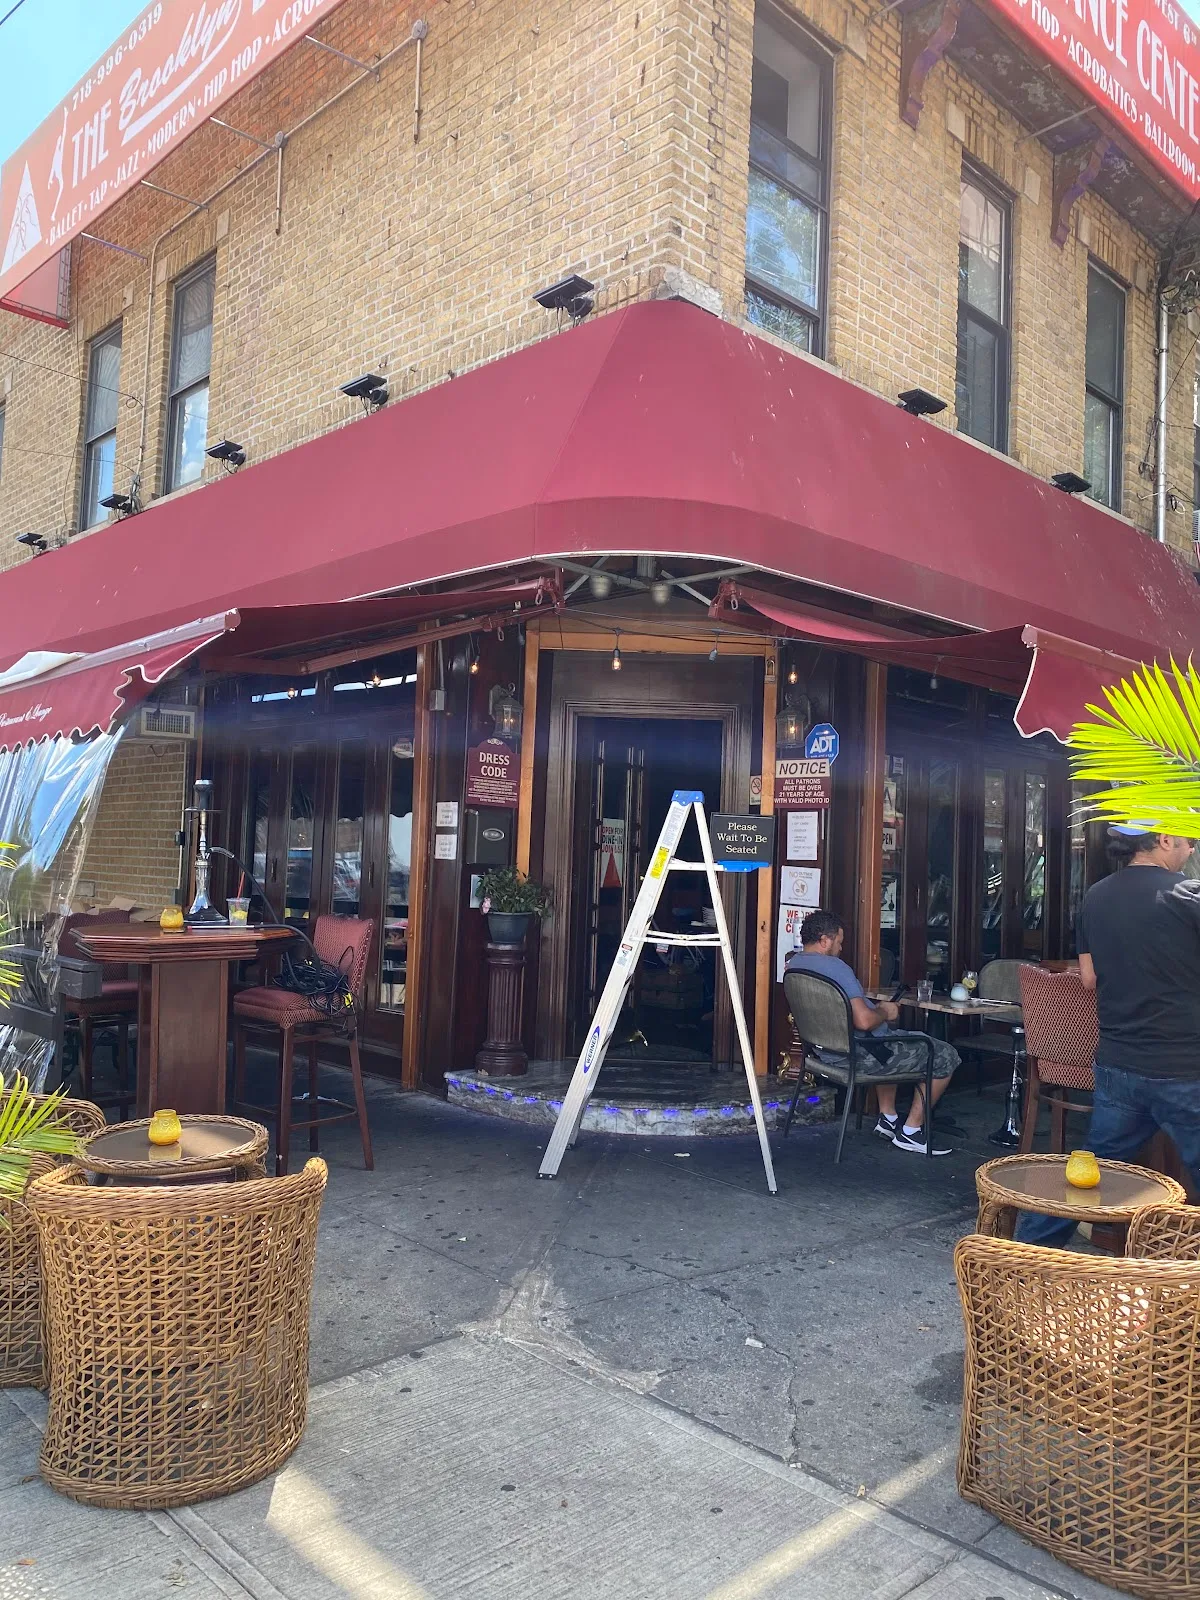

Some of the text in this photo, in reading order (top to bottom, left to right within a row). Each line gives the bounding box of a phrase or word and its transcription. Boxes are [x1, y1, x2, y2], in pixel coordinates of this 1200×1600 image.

[1154, 0, 1181, 31] EST
[72, 2, 162, 112] 718-996-0319
[71, 0, 242, 189] THE Brooklyn
[1067, 34, 1138, 123] ACROBATICS
[1144, 112, 1196, 185] BALLROOM
[49, 0, 322, 246] BALLET TAP JAZZ MODERN HIP HOP ACRO
[810, 735, 836, 754] ADT
[480, 752, 510, 765] DRESS
[481, 766, 507, 778] CODE
[780, 762, 827, 775] NOTICE
[601, 826, 614, 834] OPEN
[728, 822, 757, 831] Please
[717, 833, 768, 843] Wait To Be
[725, 845, 757, 854] Seated
[786, 909, 799, 919] WE
